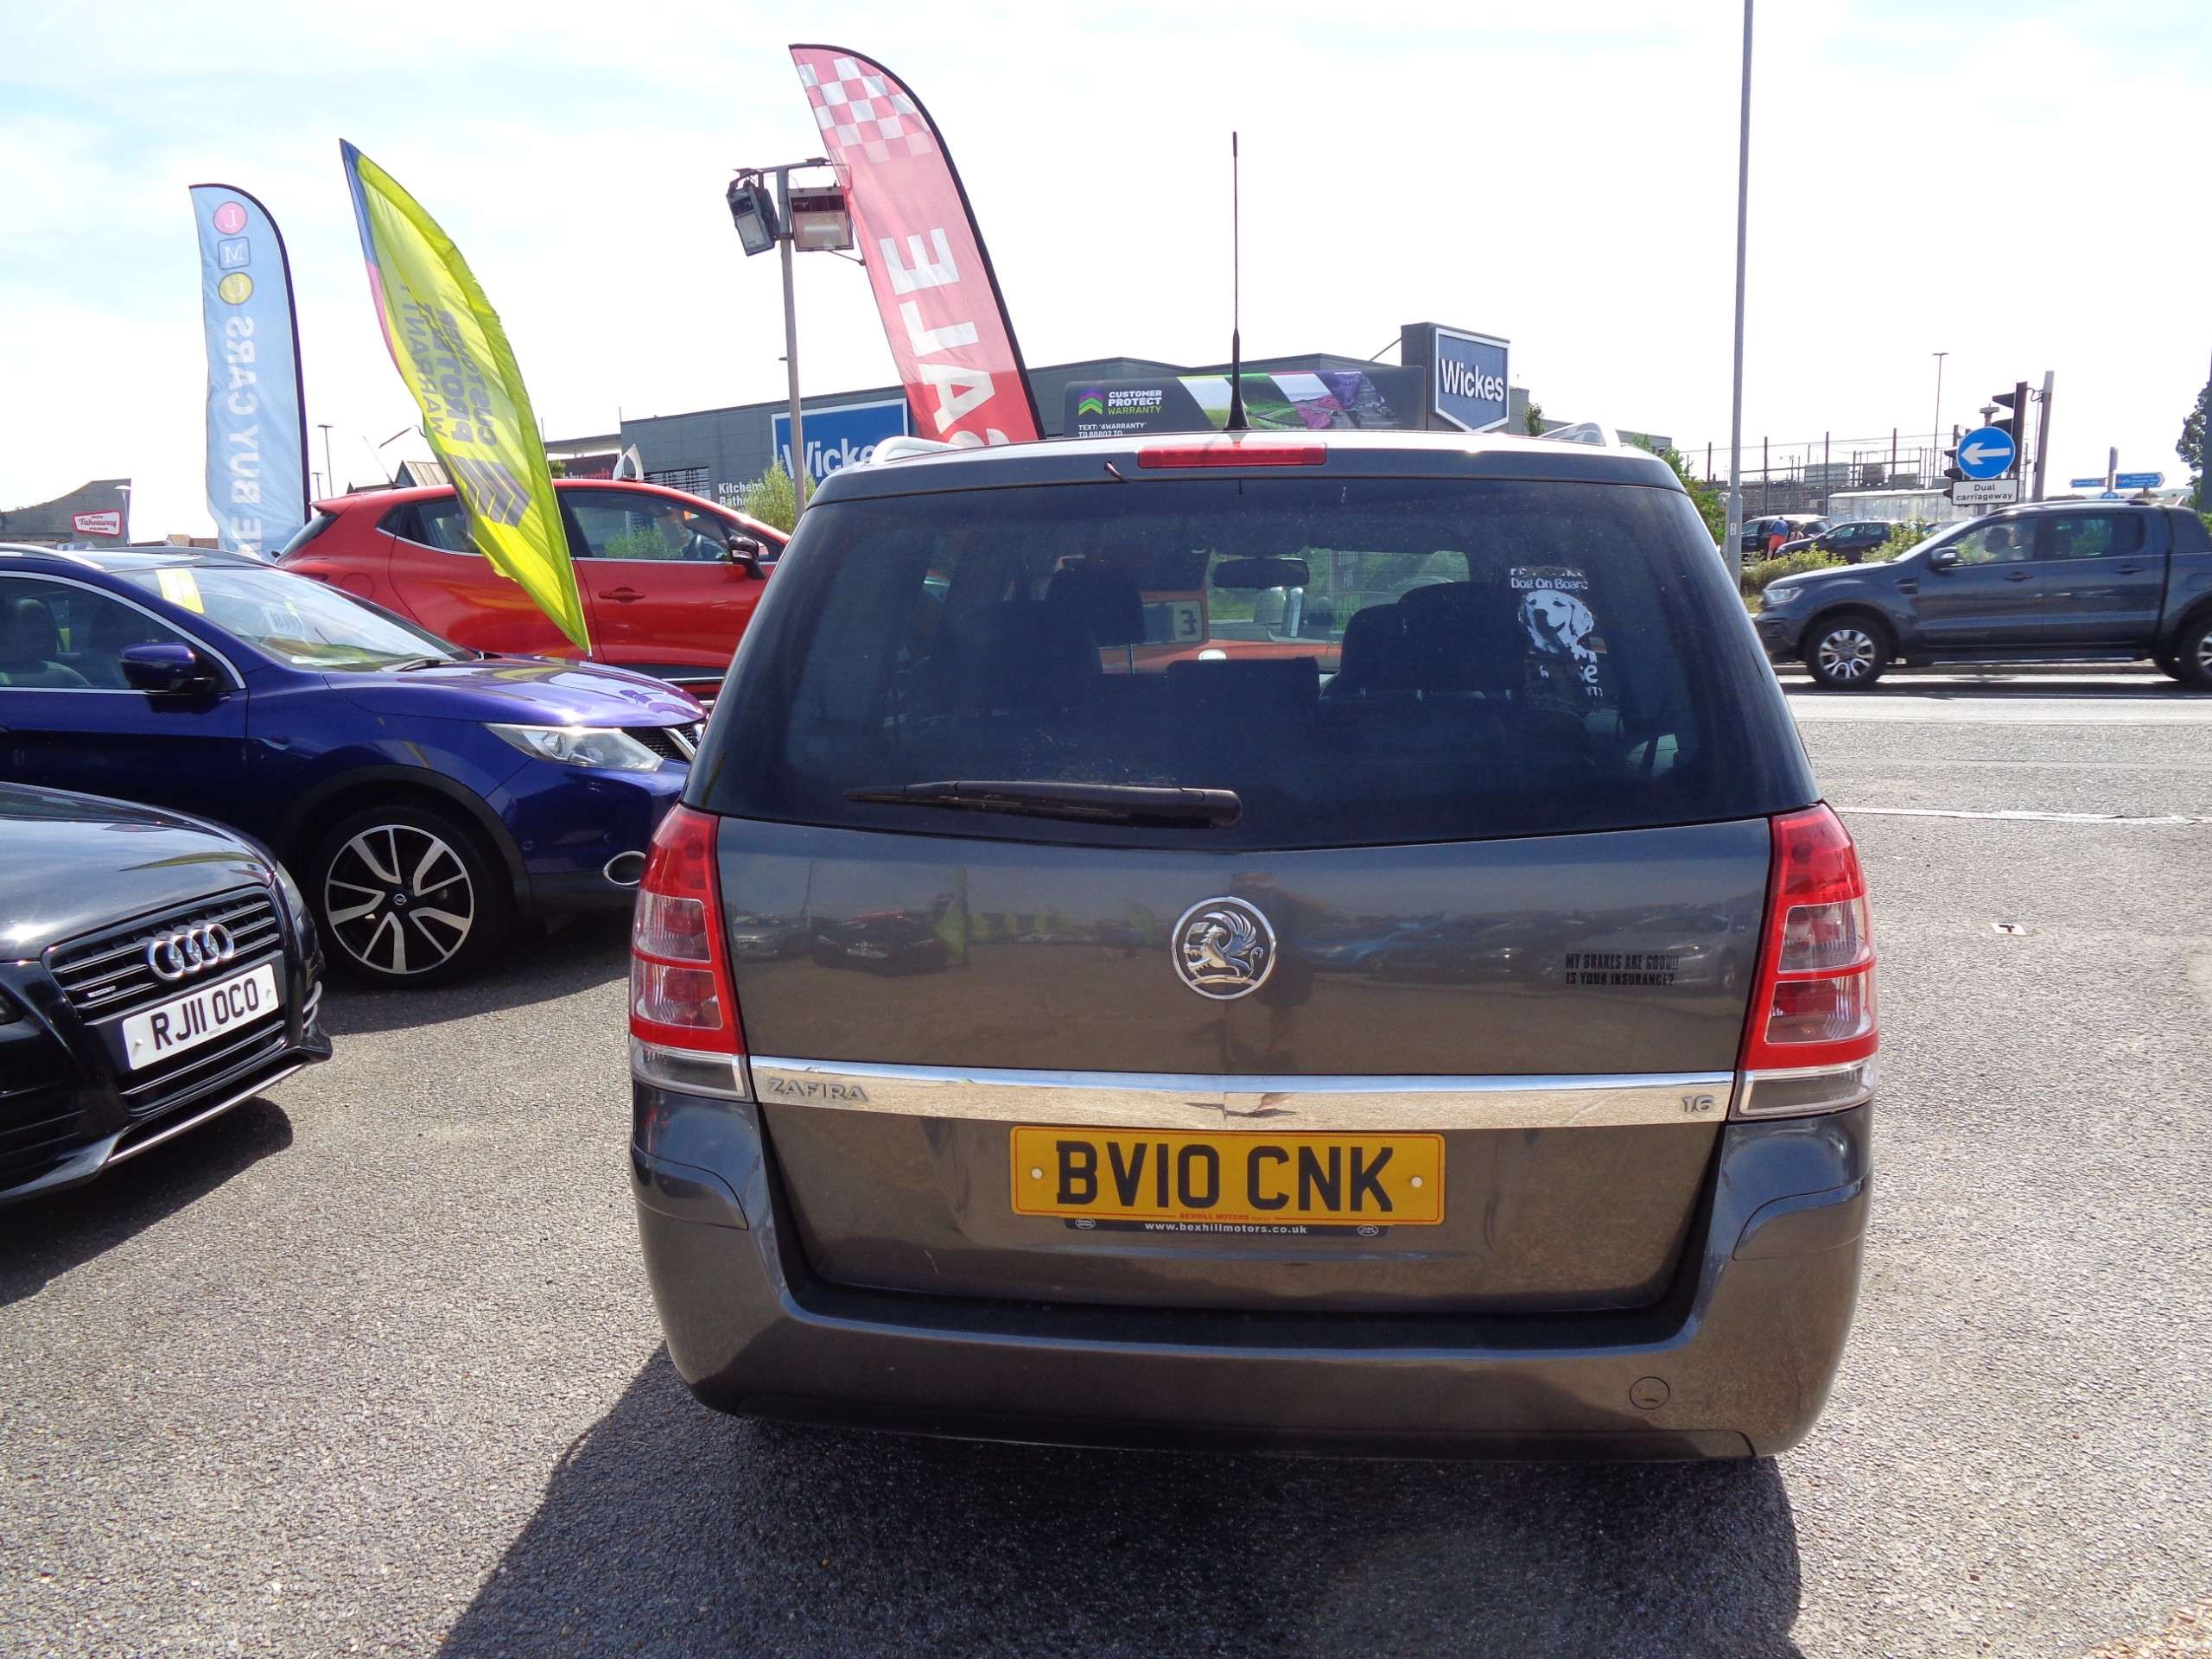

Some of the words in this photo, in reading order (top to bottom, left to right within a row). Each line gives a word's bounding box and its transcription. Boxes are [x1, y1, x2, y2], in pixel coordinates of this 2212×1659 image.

[1441, 359, 1504, 402] Wickes
[1109, 390, 1162, 398] CUSTOMER
[1108, 397, 1162, 407] PROTECT
[1108, 406, 1162, 415] WARRANTY
[782, 438, 875, 480] Wicke
[718, 481, 765, 494] Kitchens
[1955, 493, 2013, 501] carriageway
[1511, 577, 1534, 588] Dog
[1535, 577, 1553, 588] On
[1566, 954, 1580, 969] MY
[1584, 954, 1622, 969] BRAKES
[1624, 954, 1643, 969] ARE
[1566, 972, 1577, 984] IS
[1580, 972, 1607, 985] YOUR
[150, 997, 207, 1051] RJ11
[212, 977, 259, 1026] OCO
[767, 1077, 869, 1102] ZAFIRA
[1056, 1140, 1220, 1210] BV10
[1247, 1145, 1394, 1212] CNK
[1144, 1222, 1307, 1234] www.bexhillmotors.co.uk
